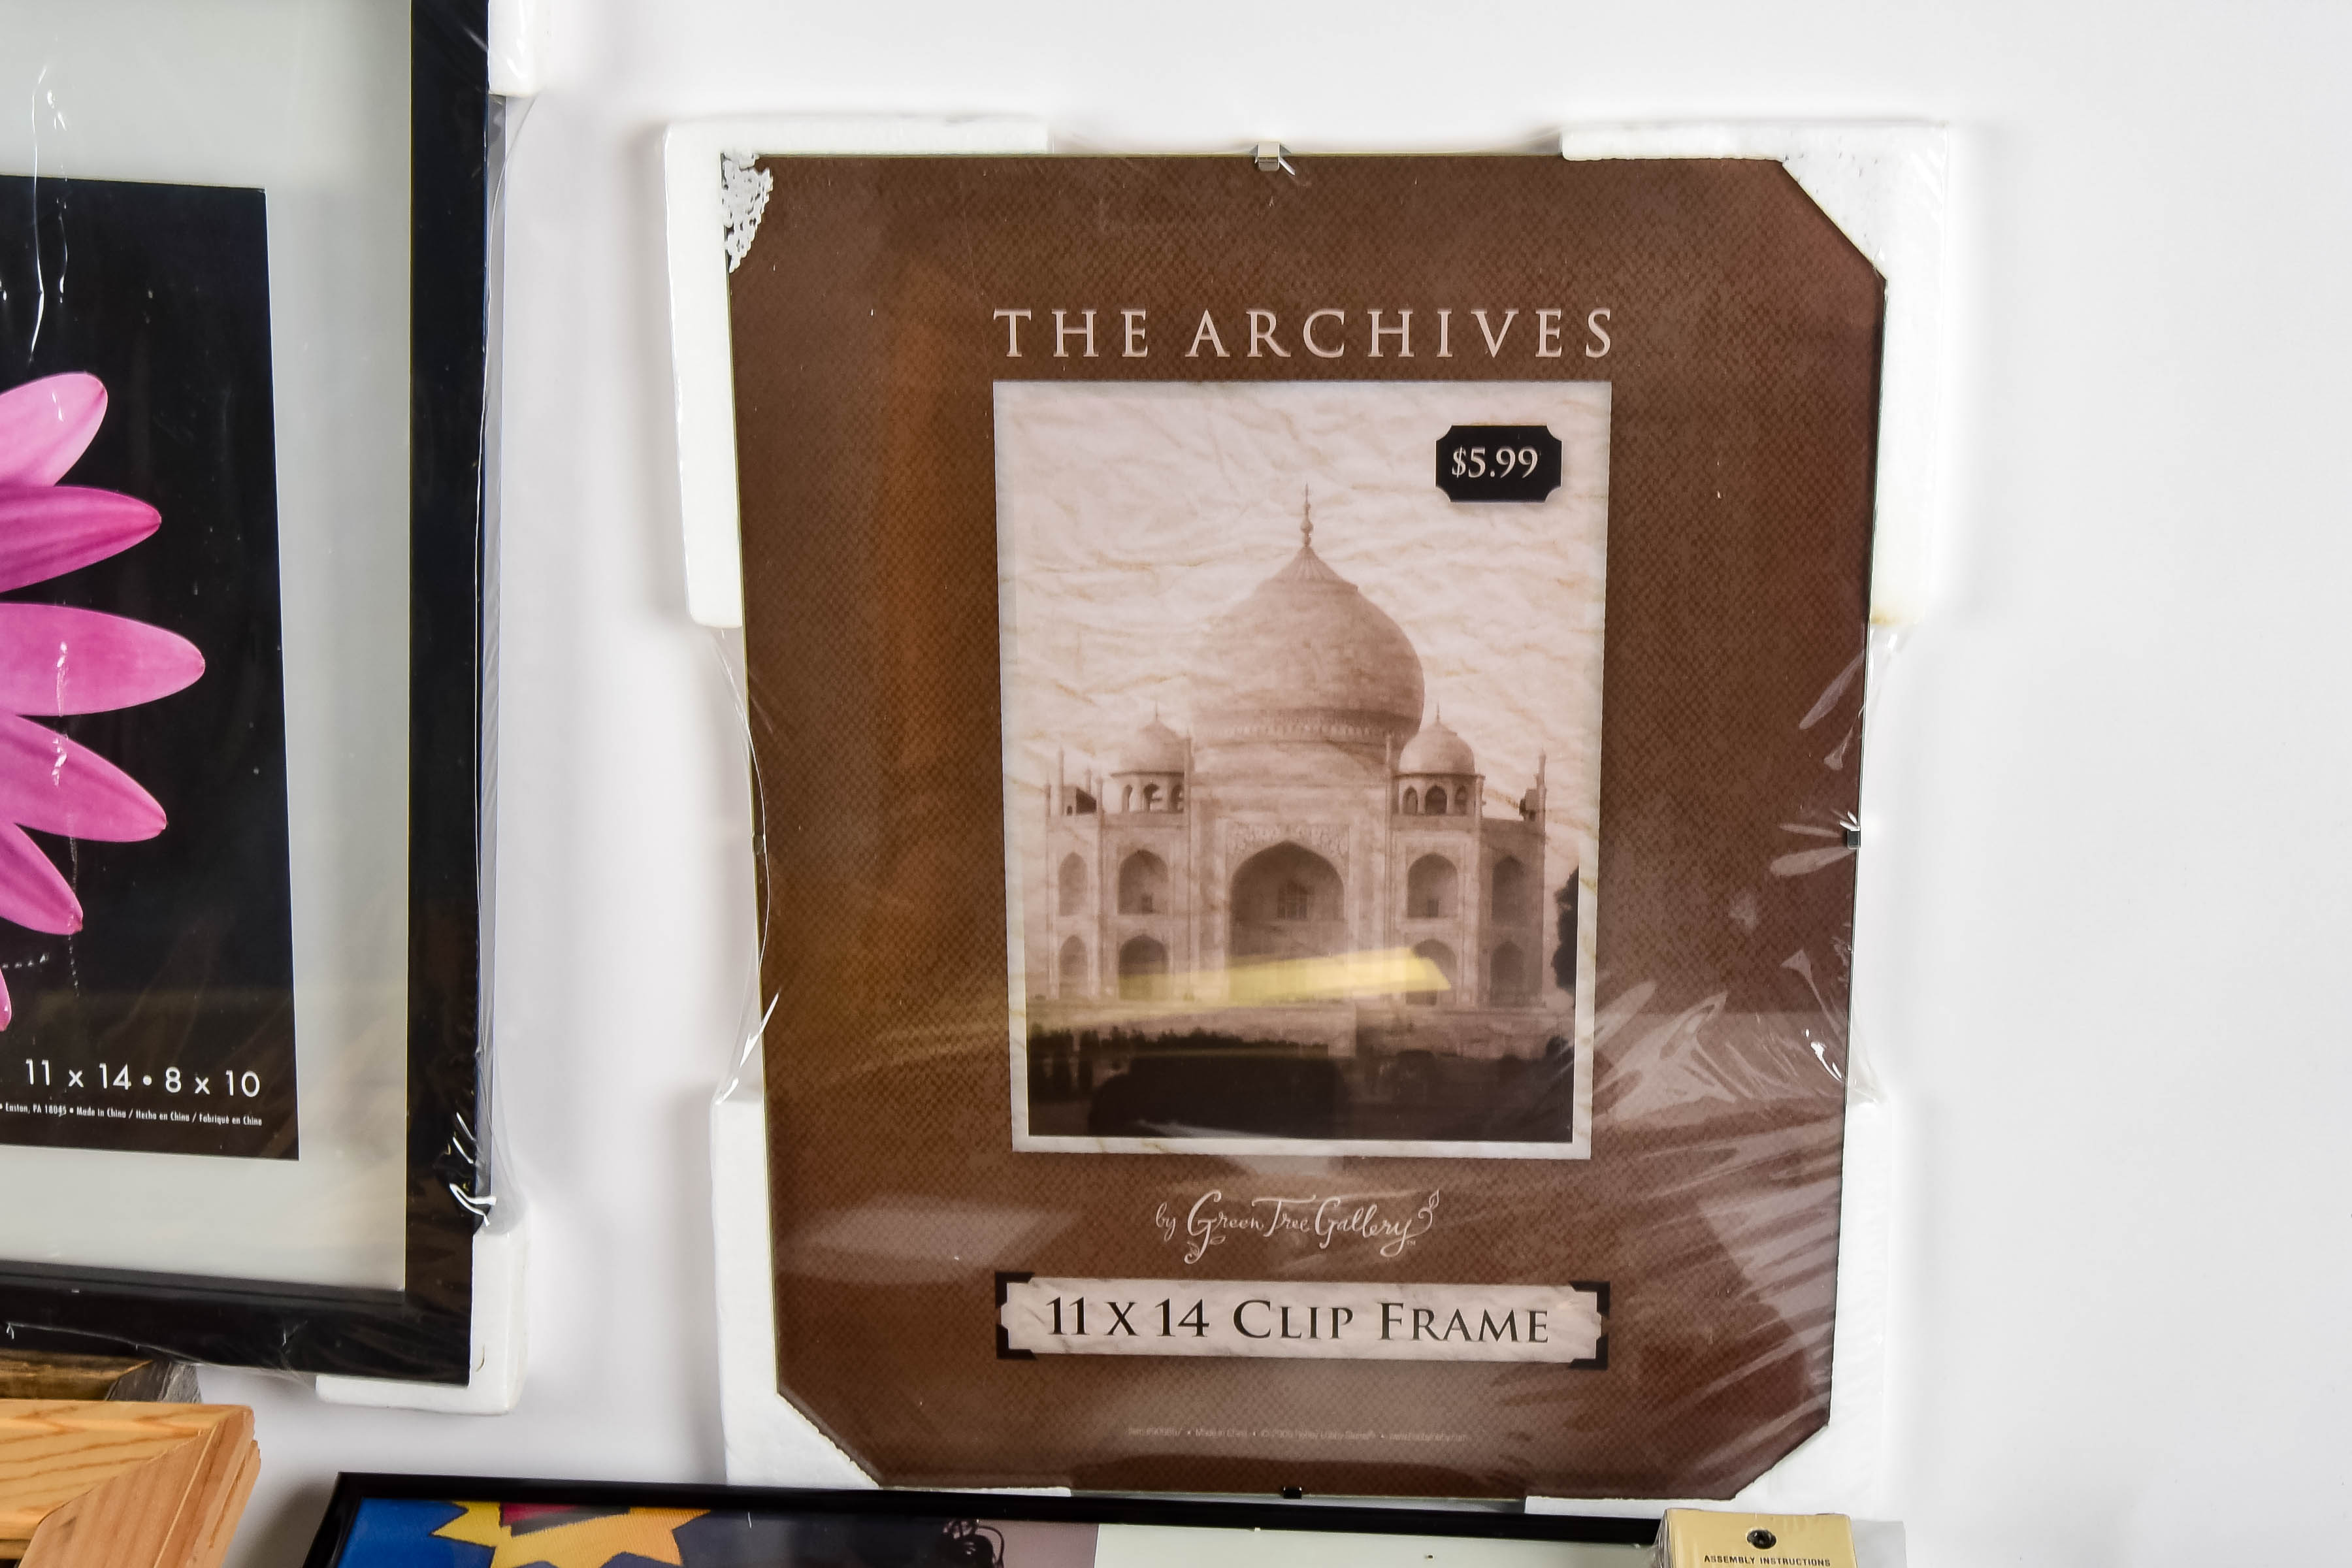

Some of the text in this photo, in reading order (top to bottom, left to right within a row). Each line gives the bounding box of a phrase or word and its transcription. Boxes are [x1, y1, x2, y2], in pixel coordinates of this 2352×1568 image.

[992, 307, 1612, 359] THE ARCHIVES
[1451, 445, 1539, 479] $5.99
[25, 1058, 261, 1098] 11 x 14 8 x 10
[33, 1102, 42, 1114] PA
[76, 1105, 95, 1117] Made
[98, 1108, 105, 1118] in
[106, 1107, 126, 1119] China
[135, 1109, 157, 1120] Hecho
[159, 1111, 168, 1121] en
[170, 1110, 190, 1122] China
[232, 1116, 241, 1125] en
[1155, 1201, 1177, 1241] by
[1185, 1189, 1264, 1264] Green
[1251, 1194, 1316, 1237] Tree
[1314, 1190, 1439, 1257] Gallery
[1046, 1296, 1090, 1336] 11
[1154, 1297, 1211, 1338] 14
[1232, 1298, 1354, 1339] CLIP
[1376, 1301, 1550, 1344] FRAME
[1703, 1554, 1831, 1567] ASSEMBLY INSTRUCTIONS
